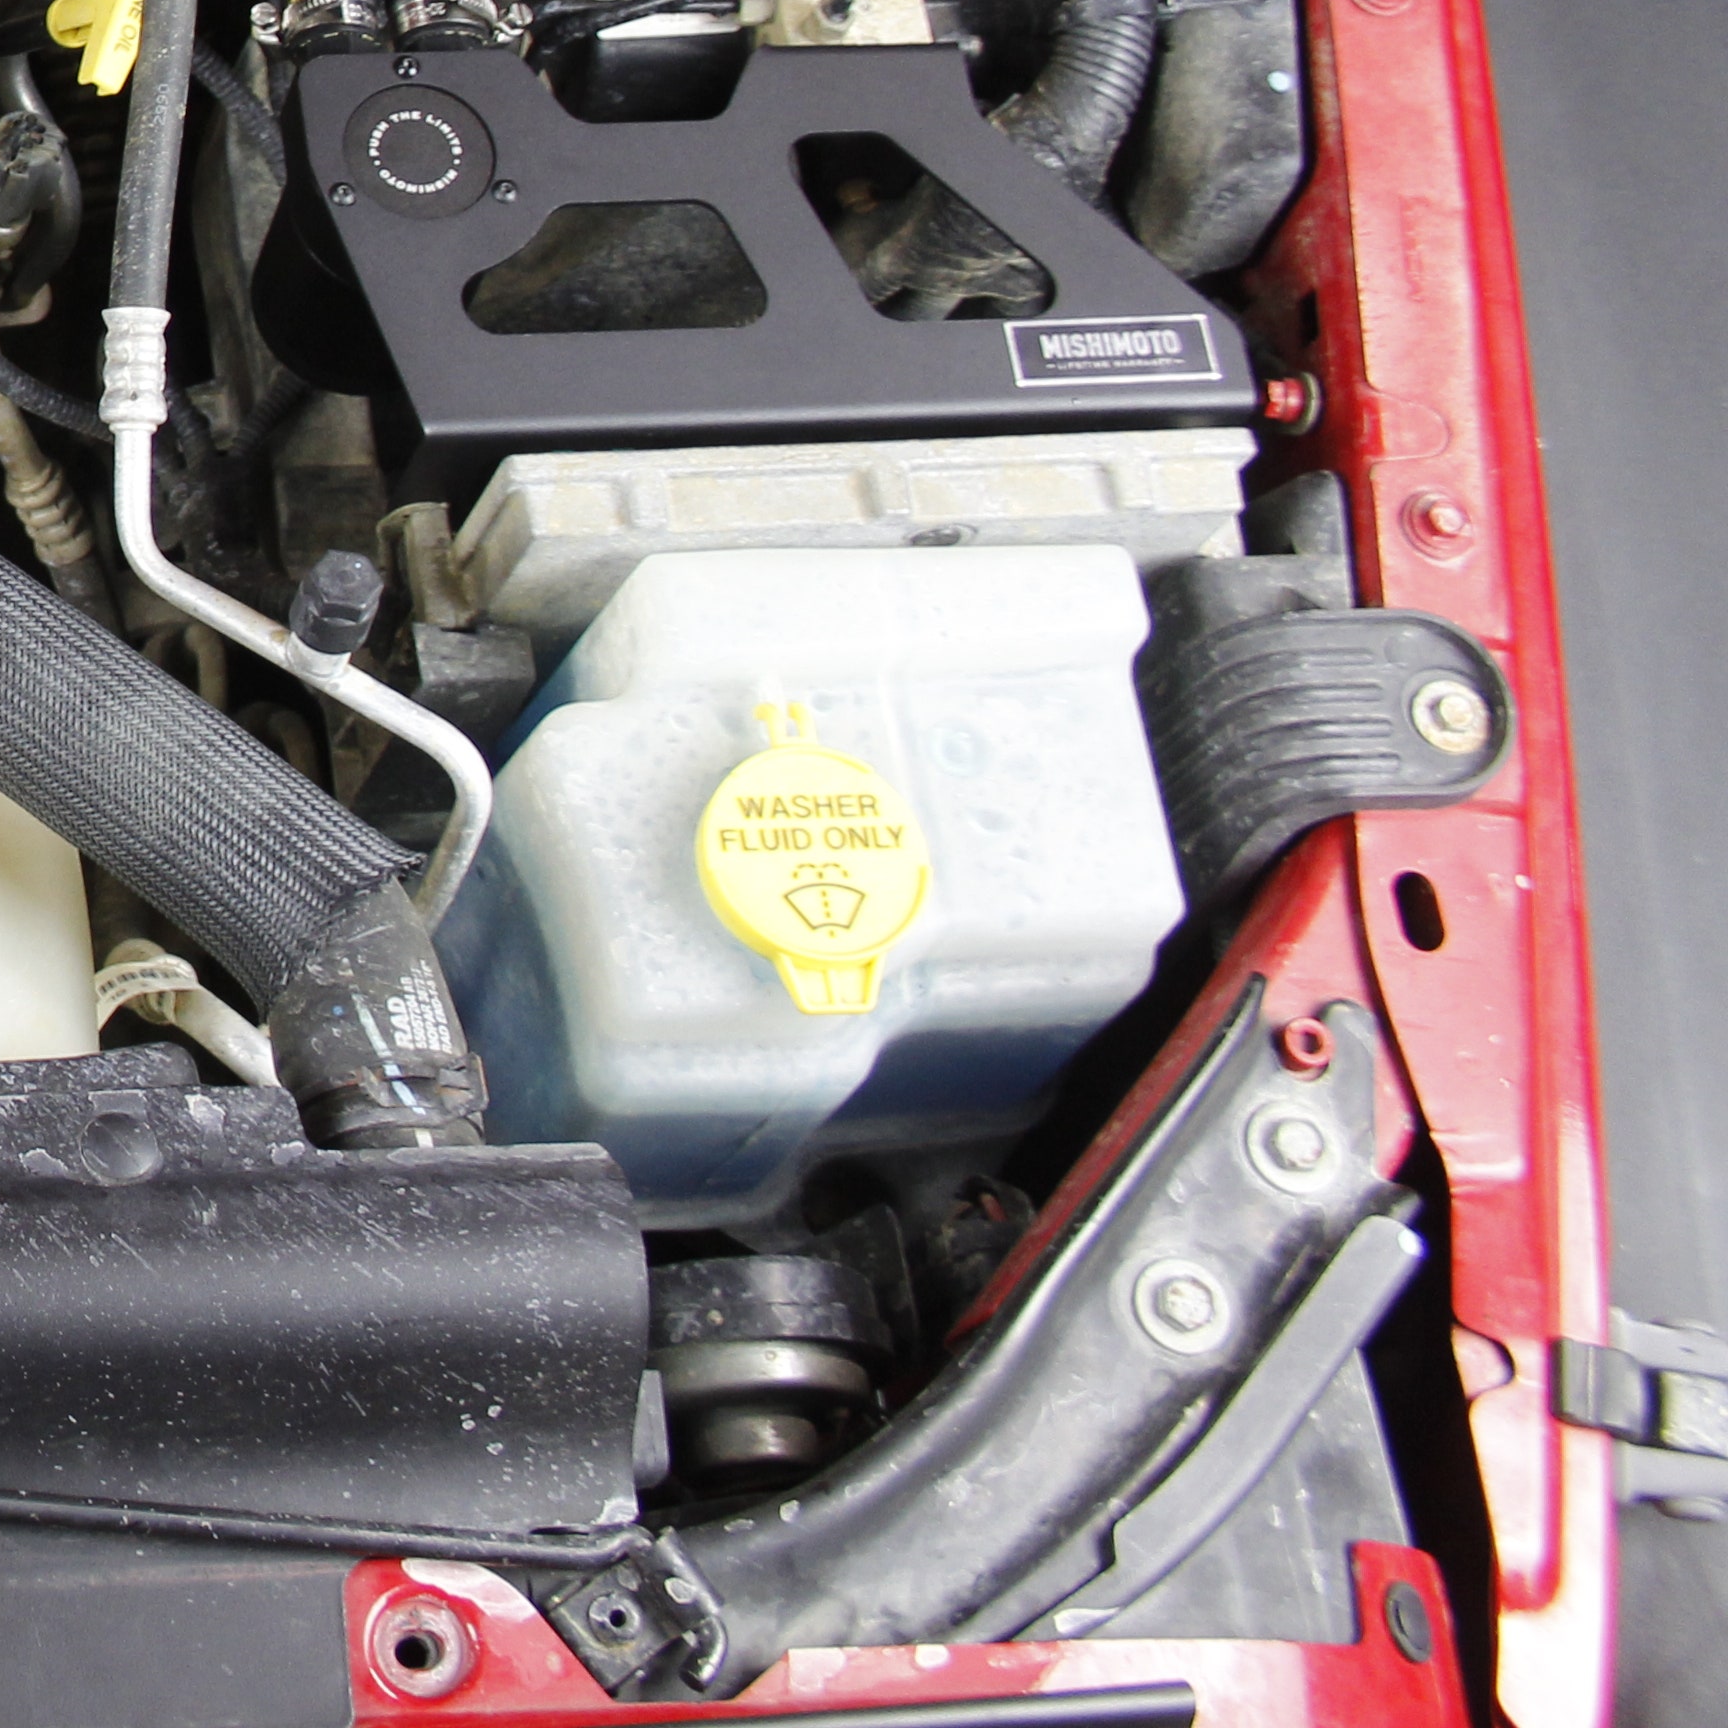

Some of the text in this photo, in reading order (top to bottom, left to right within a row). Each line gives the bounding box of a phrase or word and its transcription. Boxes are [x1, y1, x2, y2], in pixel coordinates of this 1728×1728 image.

[114, 24, 136, 52] OIL
[369, 111, 463, 157] PUSH THE LIMITS
[379, 169, 458, 194] MISHIMOTO
[1039, 329, 1182, 359] MISHIMOTO
[736, 794, 879, 818] WASHER
[719, 826, 903, 852] FLUID ONLY
[387, 996, 415, 1050] RAD
[420, 1003, 441, 1050] MOPAR
[438, 1024, 452, 1054] RAD
